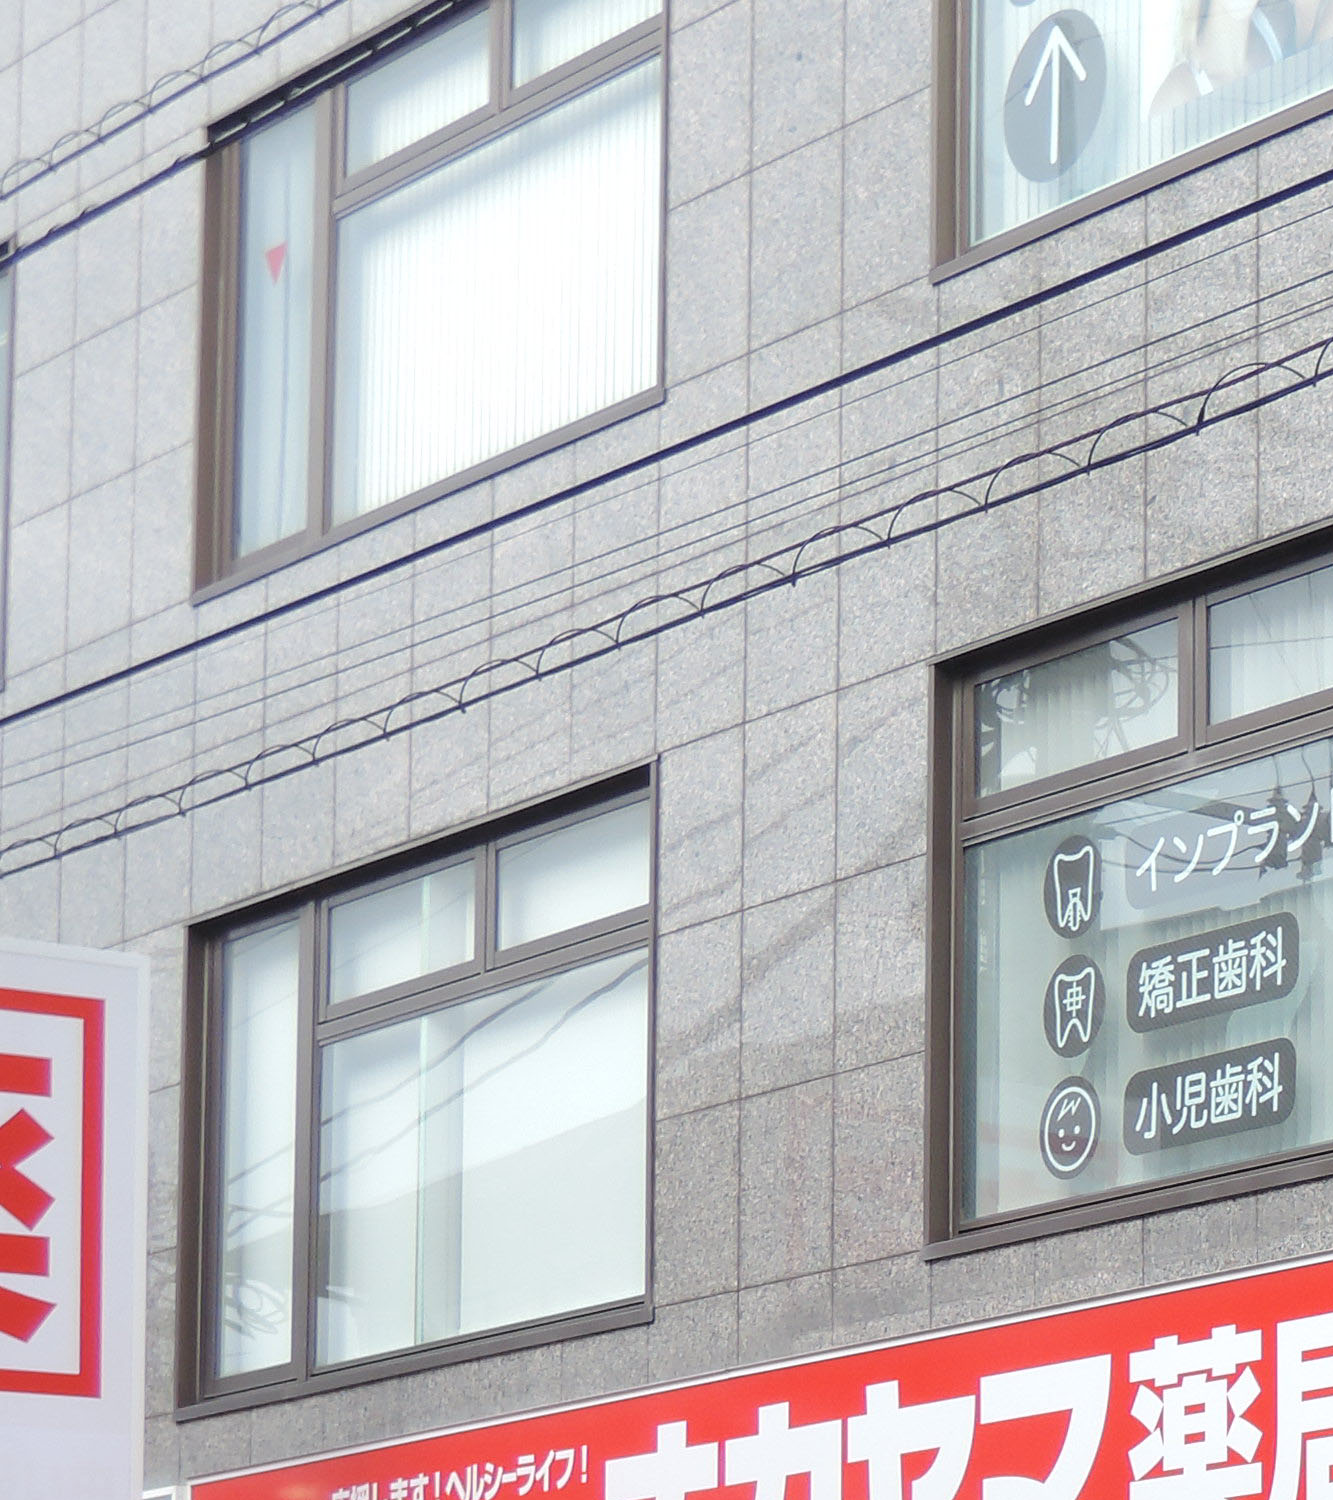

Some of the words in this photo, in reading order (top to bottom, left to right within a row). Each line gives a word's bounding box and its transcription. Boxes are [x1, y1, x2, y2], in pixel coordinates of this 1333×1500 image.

[1137, 929, 1288, 1020] 矯正歯科
[1135, 1052, 1284, 1141] 小児歯科
